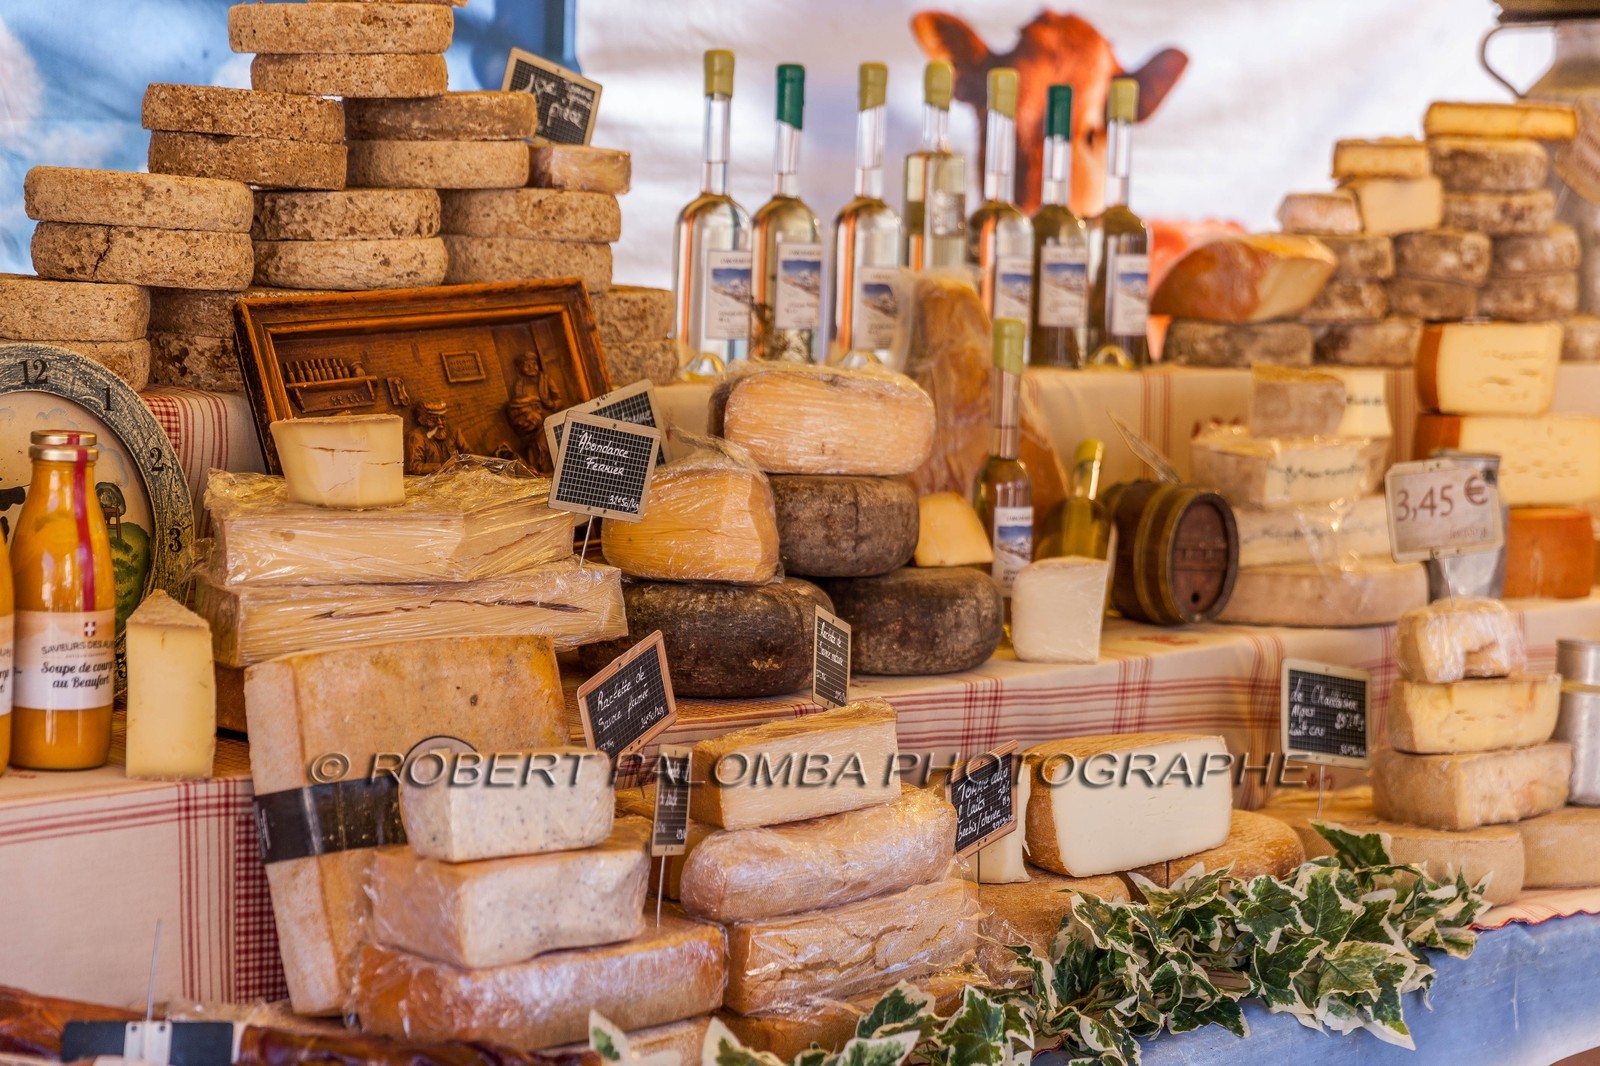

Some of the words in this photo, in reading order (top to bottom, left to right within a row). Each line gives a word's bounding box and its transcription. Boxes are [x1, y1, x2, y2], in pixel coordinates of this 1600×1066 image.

[19, 359, 49, 386] 12
[102, 387, 114, 411] 1
[578, 430, 629, 459] Abondance
[150, 447, 164, 472] 2
[1396, 485, 1454, 522] 3,45
[1463, 475, 1489, 507] €
[168, 527, 182, 553] 3
[41, 641, 86, 655] SAVEURS
[86, 640, 102, 650] DES
[41, 661, 76, 677] Soupe
[78, 662, 92, 674] de
[52, 681, 69, 689] au
[70, 674, 110, 690] Beaufort
[597, 679, 632, 712] Raclette
[957, 778, 989, 802] Tomme
